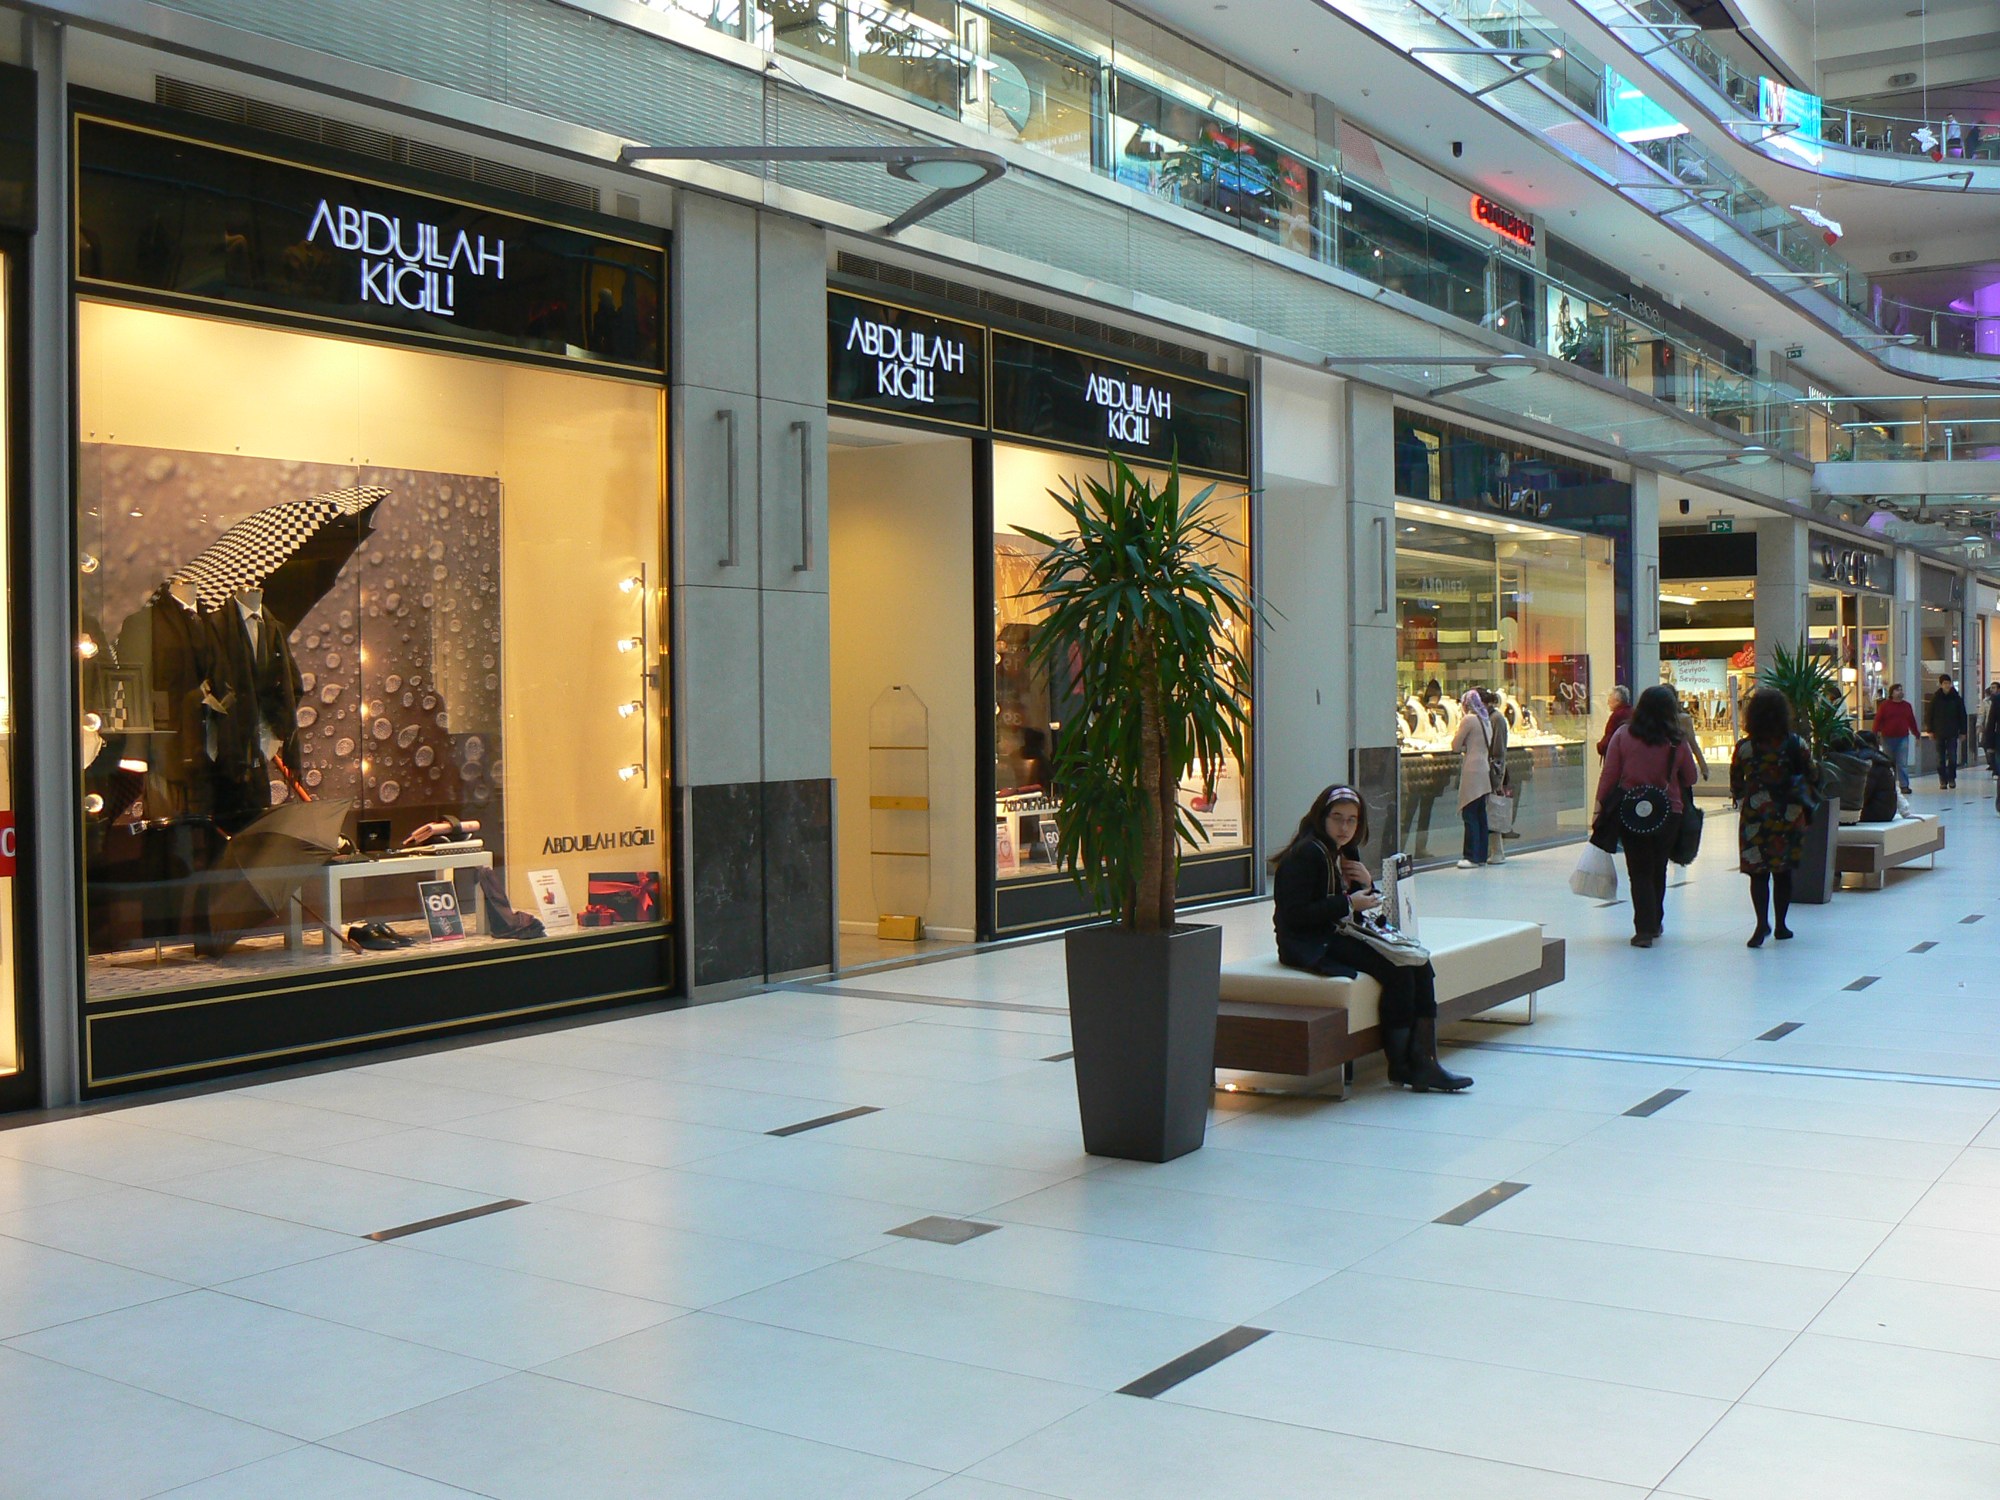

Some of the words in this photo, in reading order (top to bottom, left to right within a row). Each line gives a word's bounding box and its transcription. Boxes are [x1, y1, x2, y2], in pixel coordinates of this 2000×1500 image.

[306, 198, 505, 280] ABDULLAH
[846, 316, 965, 375] ABDULLAH
[1085, 371, 1171, 420] ABDULLAH
